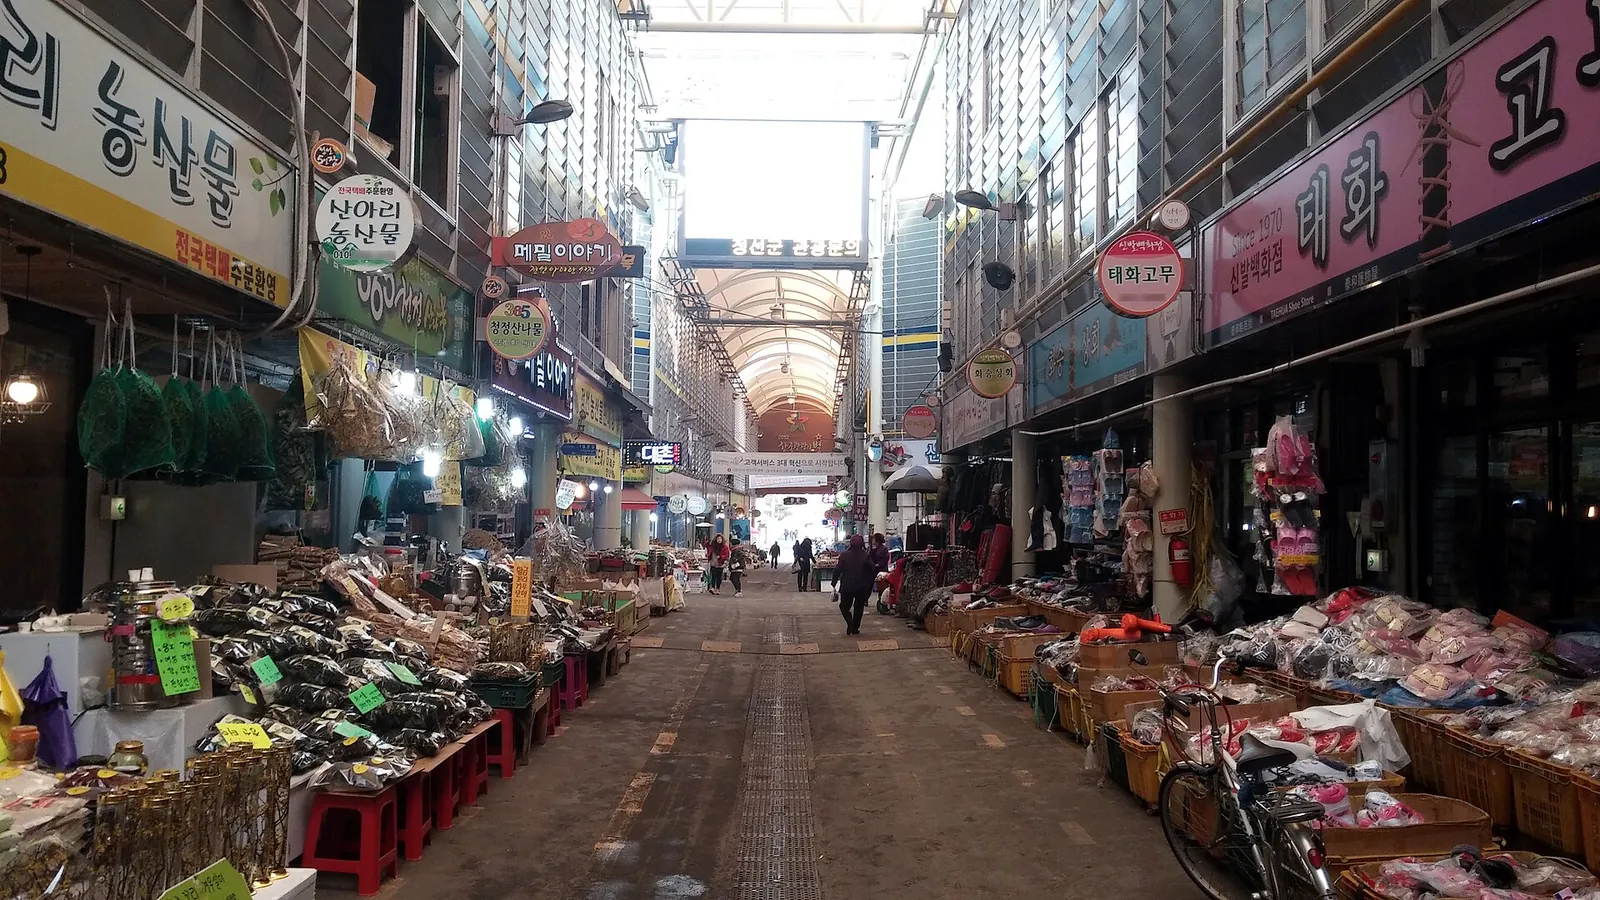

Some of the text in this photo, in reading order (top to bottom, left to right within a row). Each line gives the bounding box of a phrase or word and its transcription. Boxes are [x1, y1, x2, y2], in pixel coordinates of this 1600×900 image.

[93, 59, 240, 229] 농산물
[329, 198, 401, 220] 산아리
[1295, 132, 1389, 268] 태화
[328, 221, 402, 245] 농산물
[1231, 207, 1283, 258] Since 1970
[513, 242, 613, 263] 메밀이야기
[1119, 239, 1165, 253] 신발백화점
[1107, 265, 1175, 285] 태화고무
[1230, 238, 1284, 296] 신발백화점
[504, 302, 531, 319] 365
[1288, 299, 1303, 314] Shoe
[1301, 295, 1315, 308] Store
[490, 321, 543, 337] 청정산나물
[744, 459, 776, 467] 고객서비스
[776, 459, 788, 467] 3대
[789, 459, 815, 467] 혁신으로
